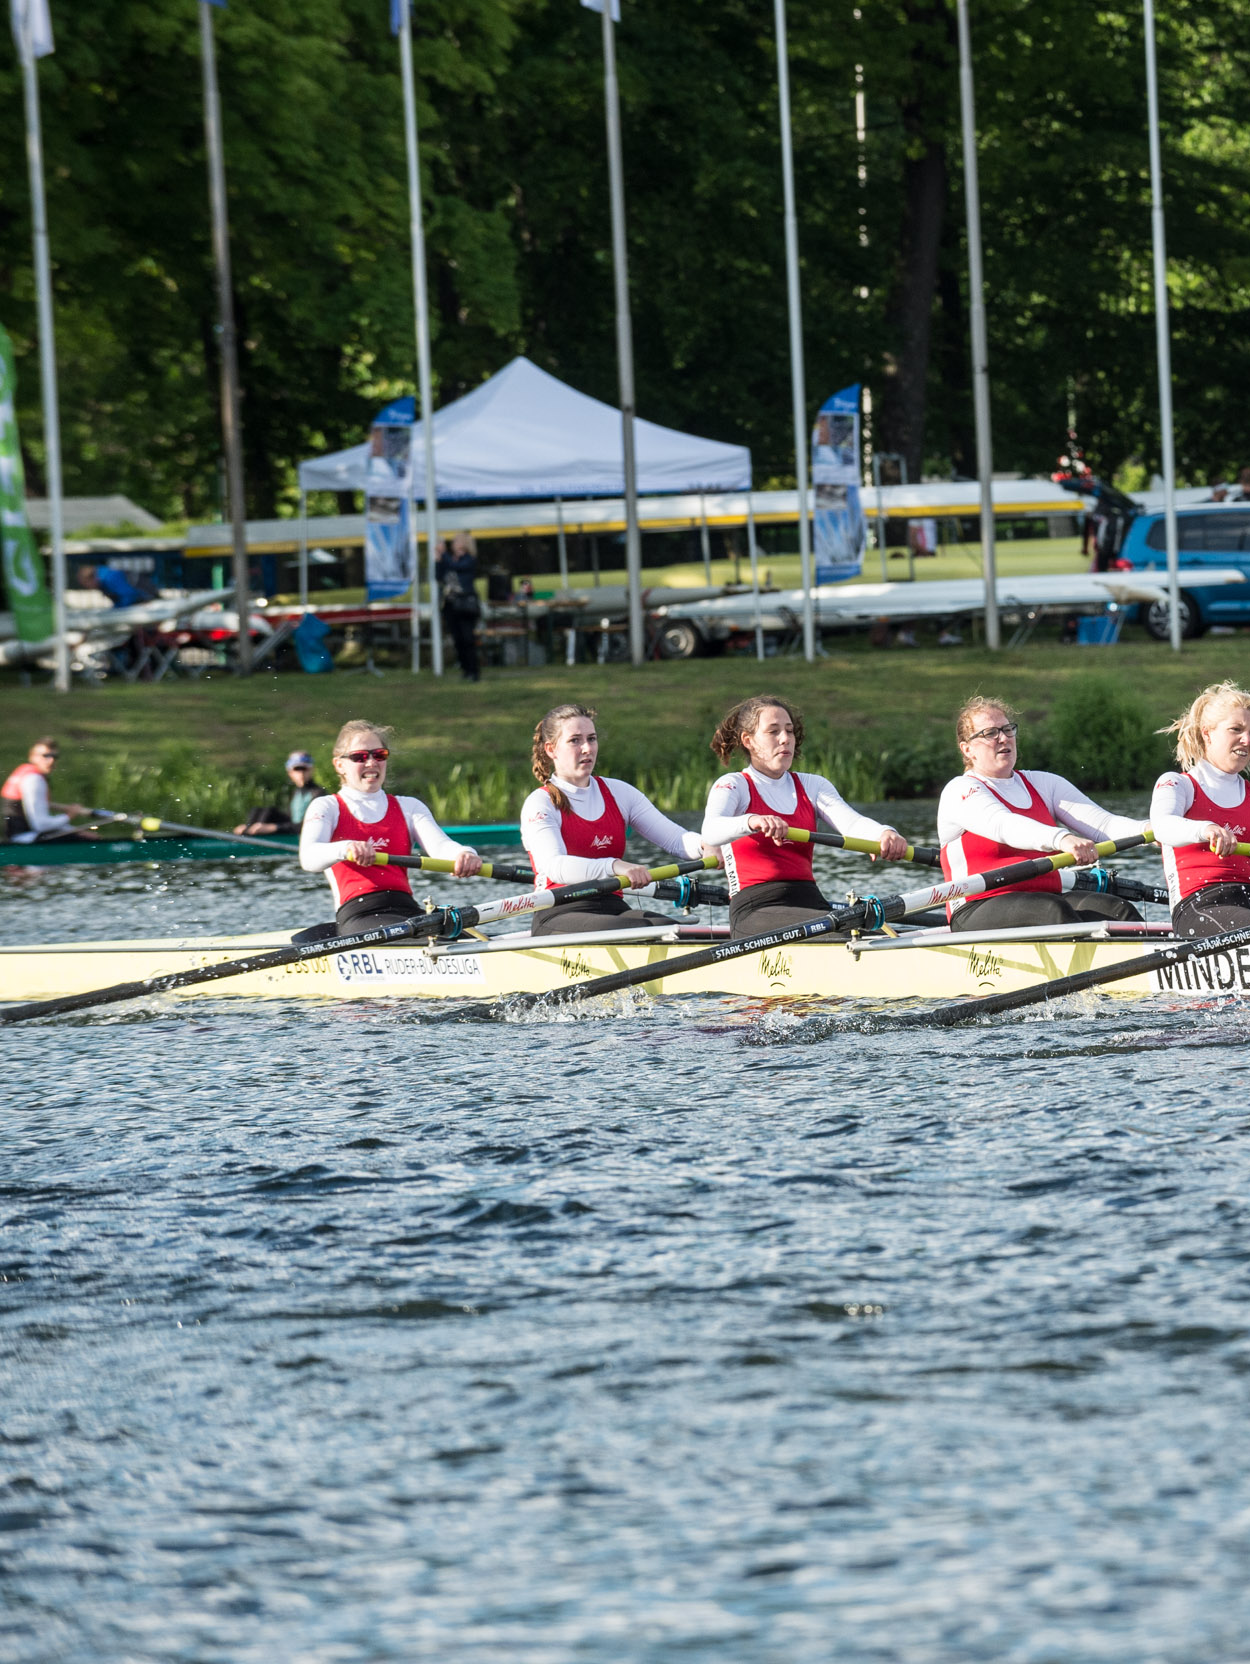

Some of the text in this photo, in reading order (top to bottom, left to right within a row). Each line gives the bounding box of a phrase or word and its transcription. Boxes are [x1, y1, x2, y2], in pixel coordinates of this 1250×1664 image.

[498, 895, 536, 915] Melitta
[810, 922, 826, 932] RBL
[300, 932, 382, 956] STARK. SCHNELL. GUT.
[715, 929, 802, 959] STARK. SCHNELL. GUT.
[1196, 938, 1224, 952] STARK.
[350, 953, 480, 975] RBL RUDER-BUNDESLIGA
[758, 951, 793, 978] Melitta
[967, 946, 1002, 978] Melitta
